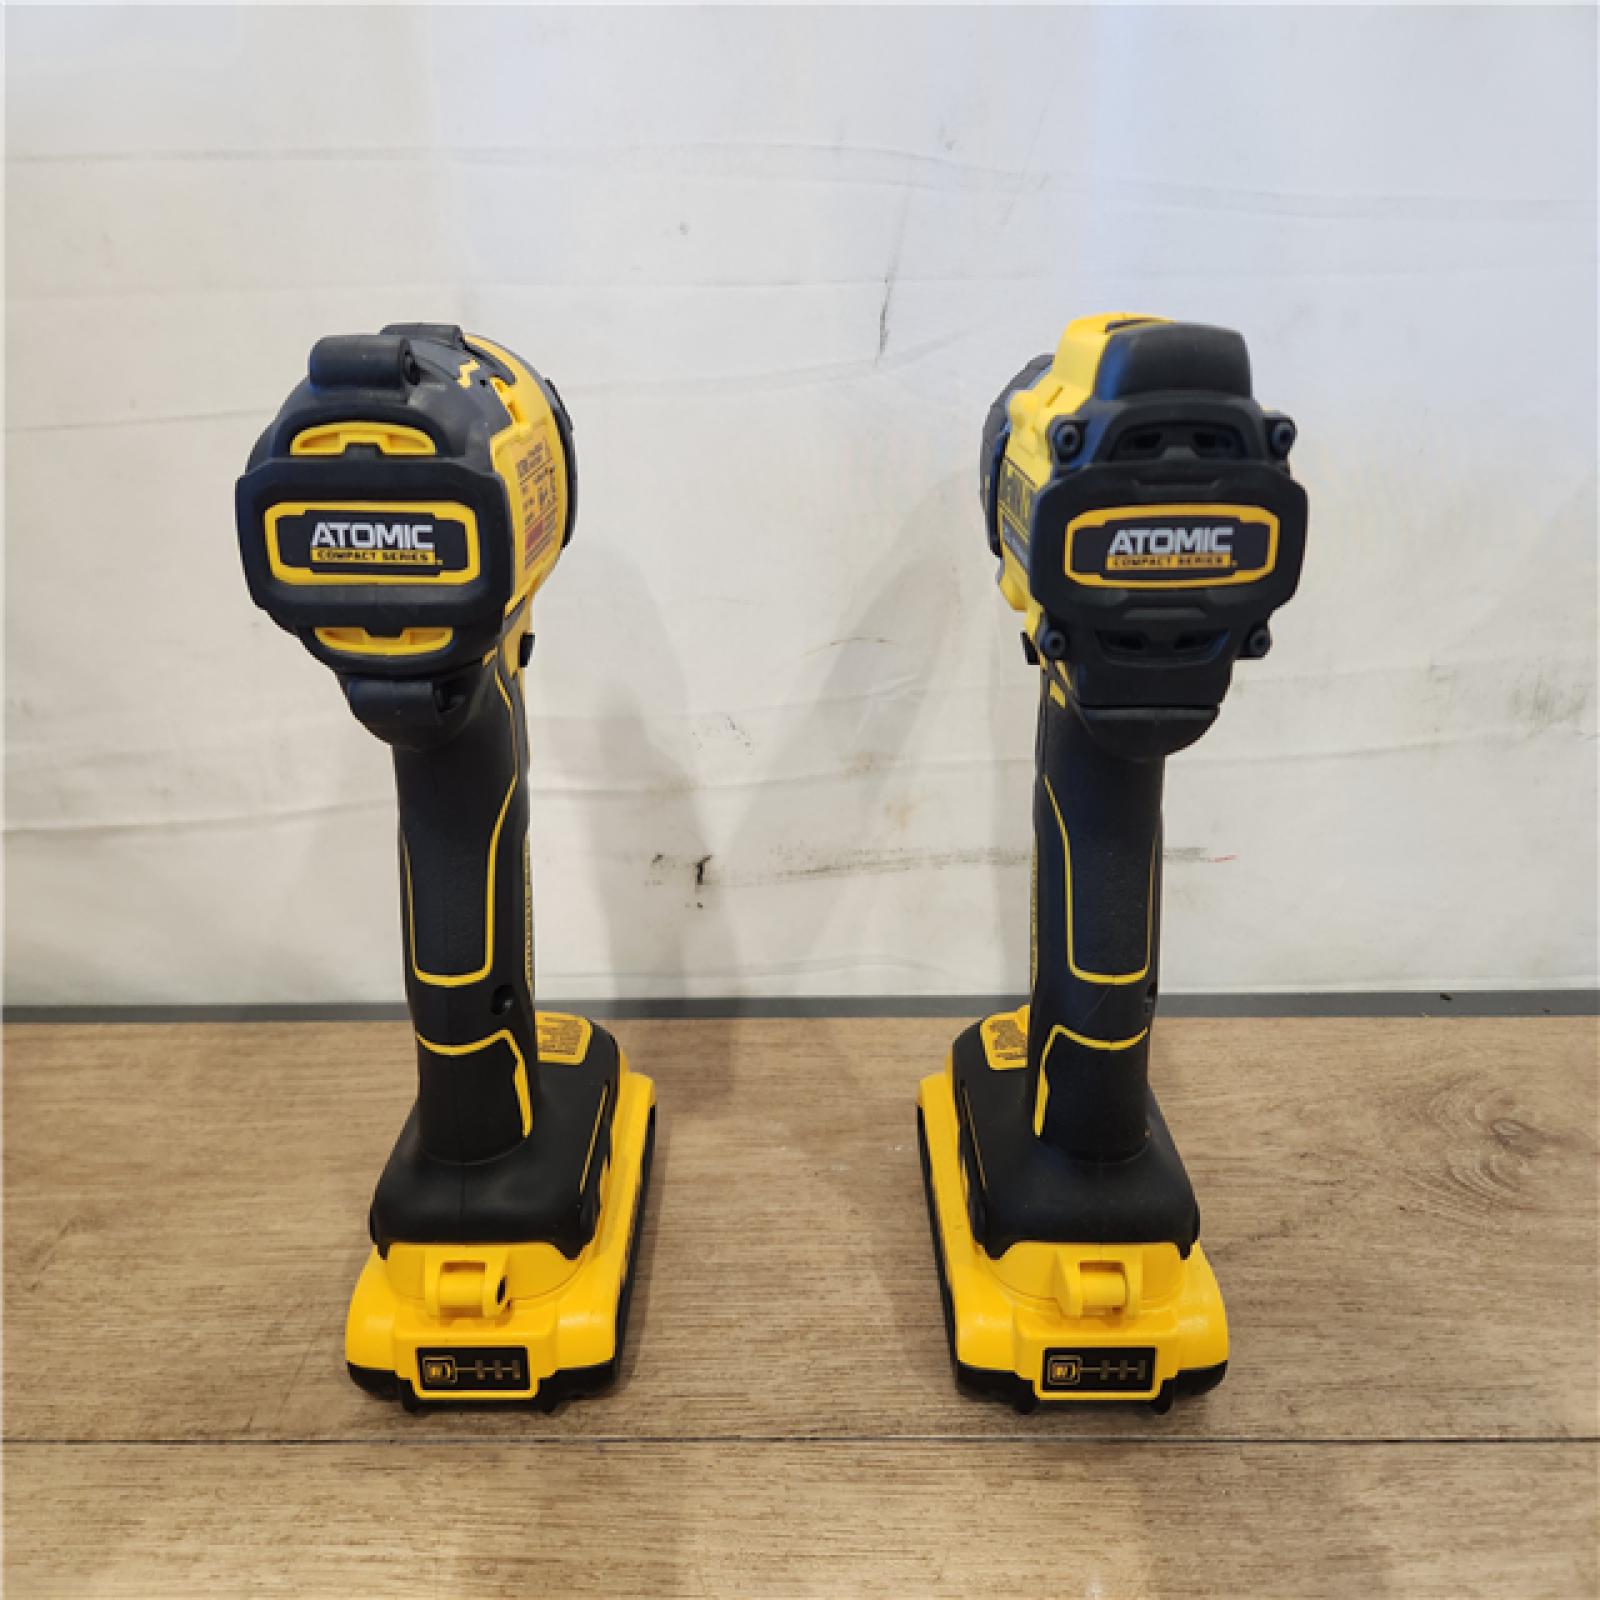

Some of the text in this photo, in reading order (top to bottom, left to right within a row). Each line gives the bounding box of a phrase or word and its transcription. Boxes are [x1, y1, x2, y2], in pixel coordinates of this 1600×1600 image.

[311, 521, 434, 549] ATOMIC
[1109, 527, 1233, 555] ATOMIC
[316, 550, 429, 562] COMPACT SERIES
[1112, 555, 1224, 567] COMPACT SERIES
